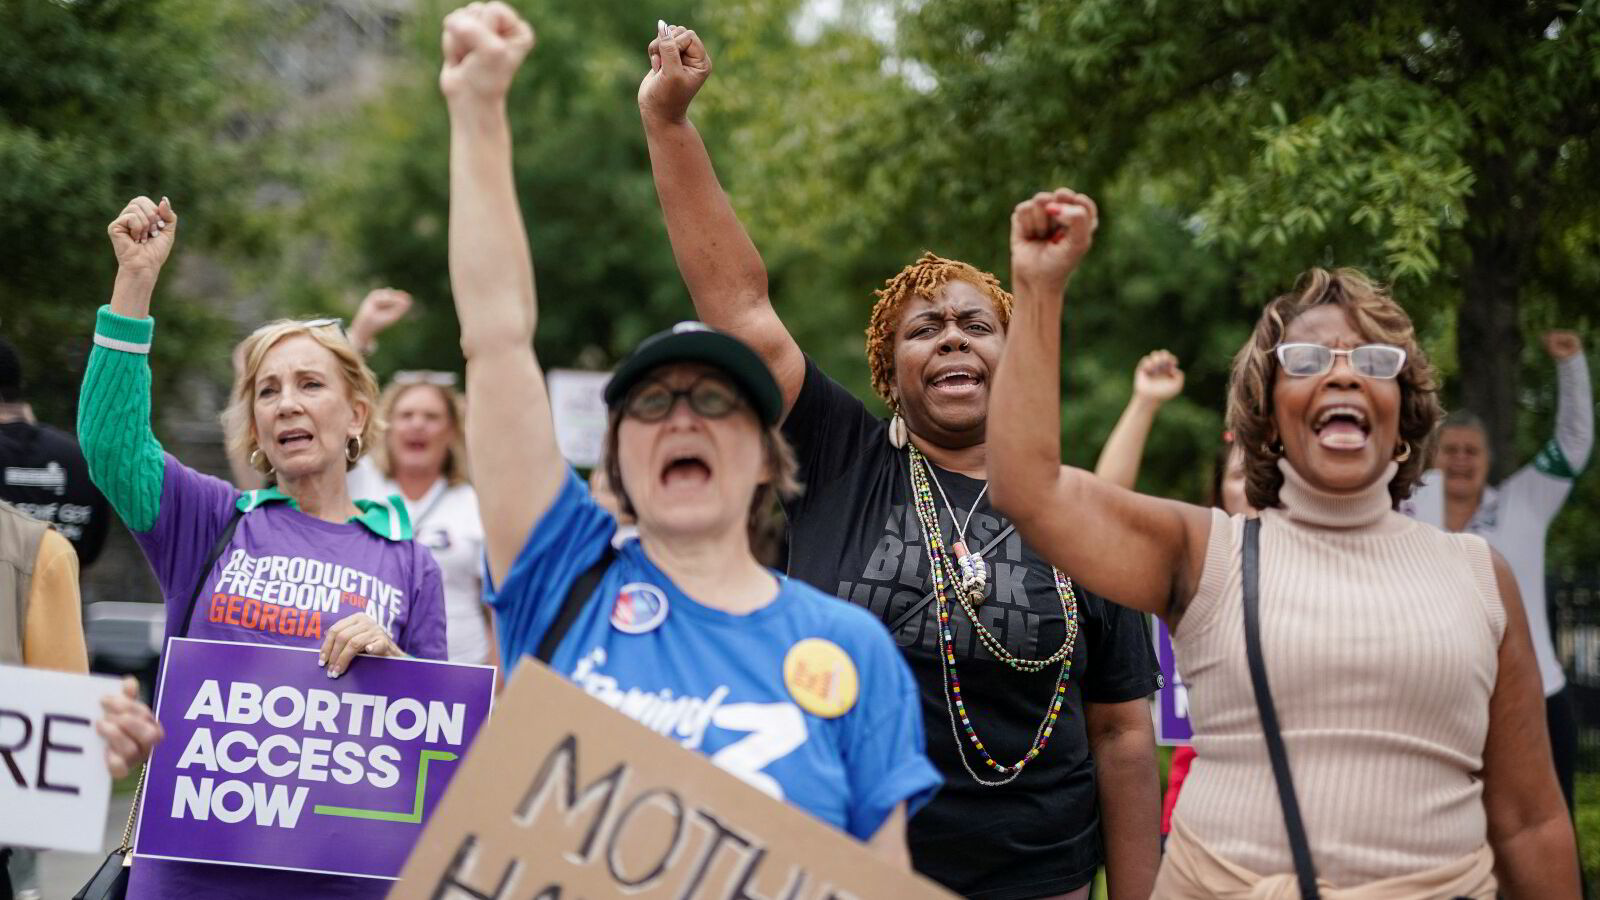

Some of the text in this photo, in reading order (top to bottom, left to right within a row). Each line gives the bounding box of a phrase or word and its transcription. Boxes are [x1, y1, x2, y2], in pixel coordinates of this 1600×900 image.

[215, 570, 341, 613] FREEDOM
[226, 549, 403, 615] REPRODUCTIVE
[862, 534, 1030, 608] BLK
[208, 594, 321, 640] GEORGIA
[184, 679, 466, 746] ABORTION
[176, 728, 402, 788] ACCESS
[171, 776, 310, 829] NOW
